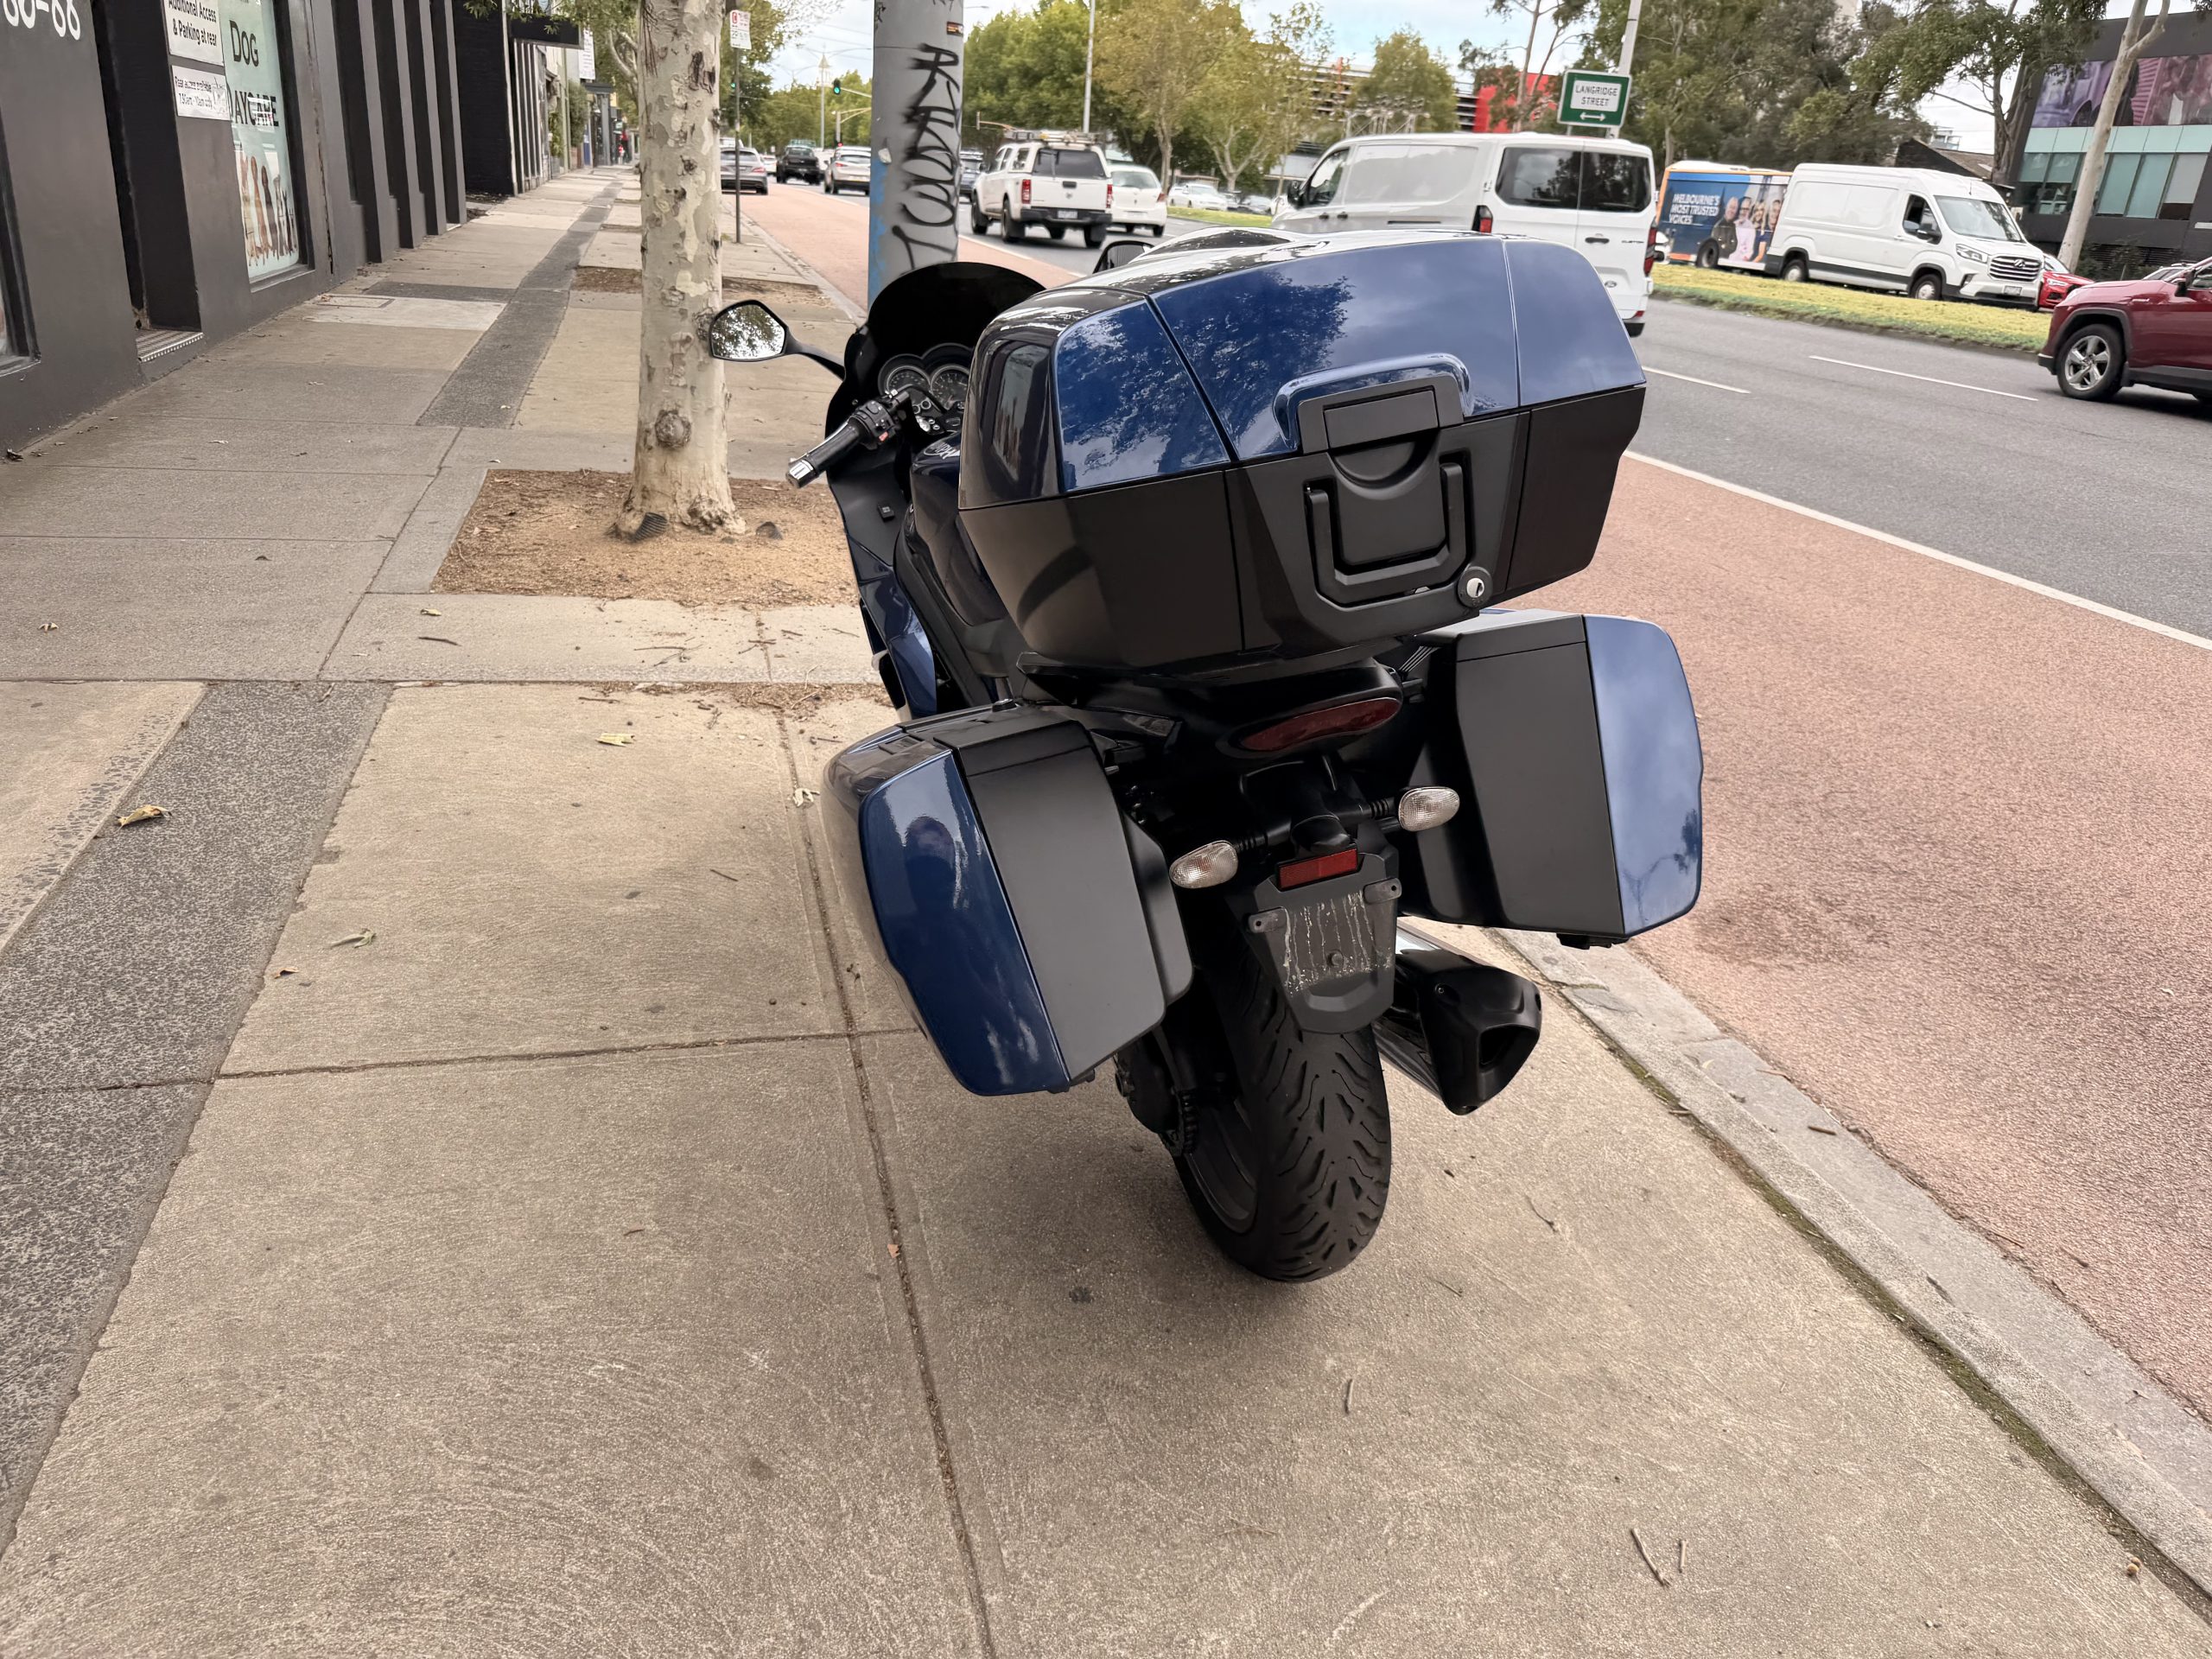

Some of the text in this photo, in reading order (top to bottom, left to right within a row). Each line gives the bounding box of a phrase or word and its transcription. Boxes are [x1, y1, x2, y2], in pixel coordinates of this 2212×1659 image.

[200, 2, 217, 22] Access
[173, 17, 217, 46] & Parking at rear
[1575, 85, 1618, 96] LANGRIDGE
[1581, 97, 1610, 106] STREET
[1670, 204, 1719, 217] MOST TRUSTED
